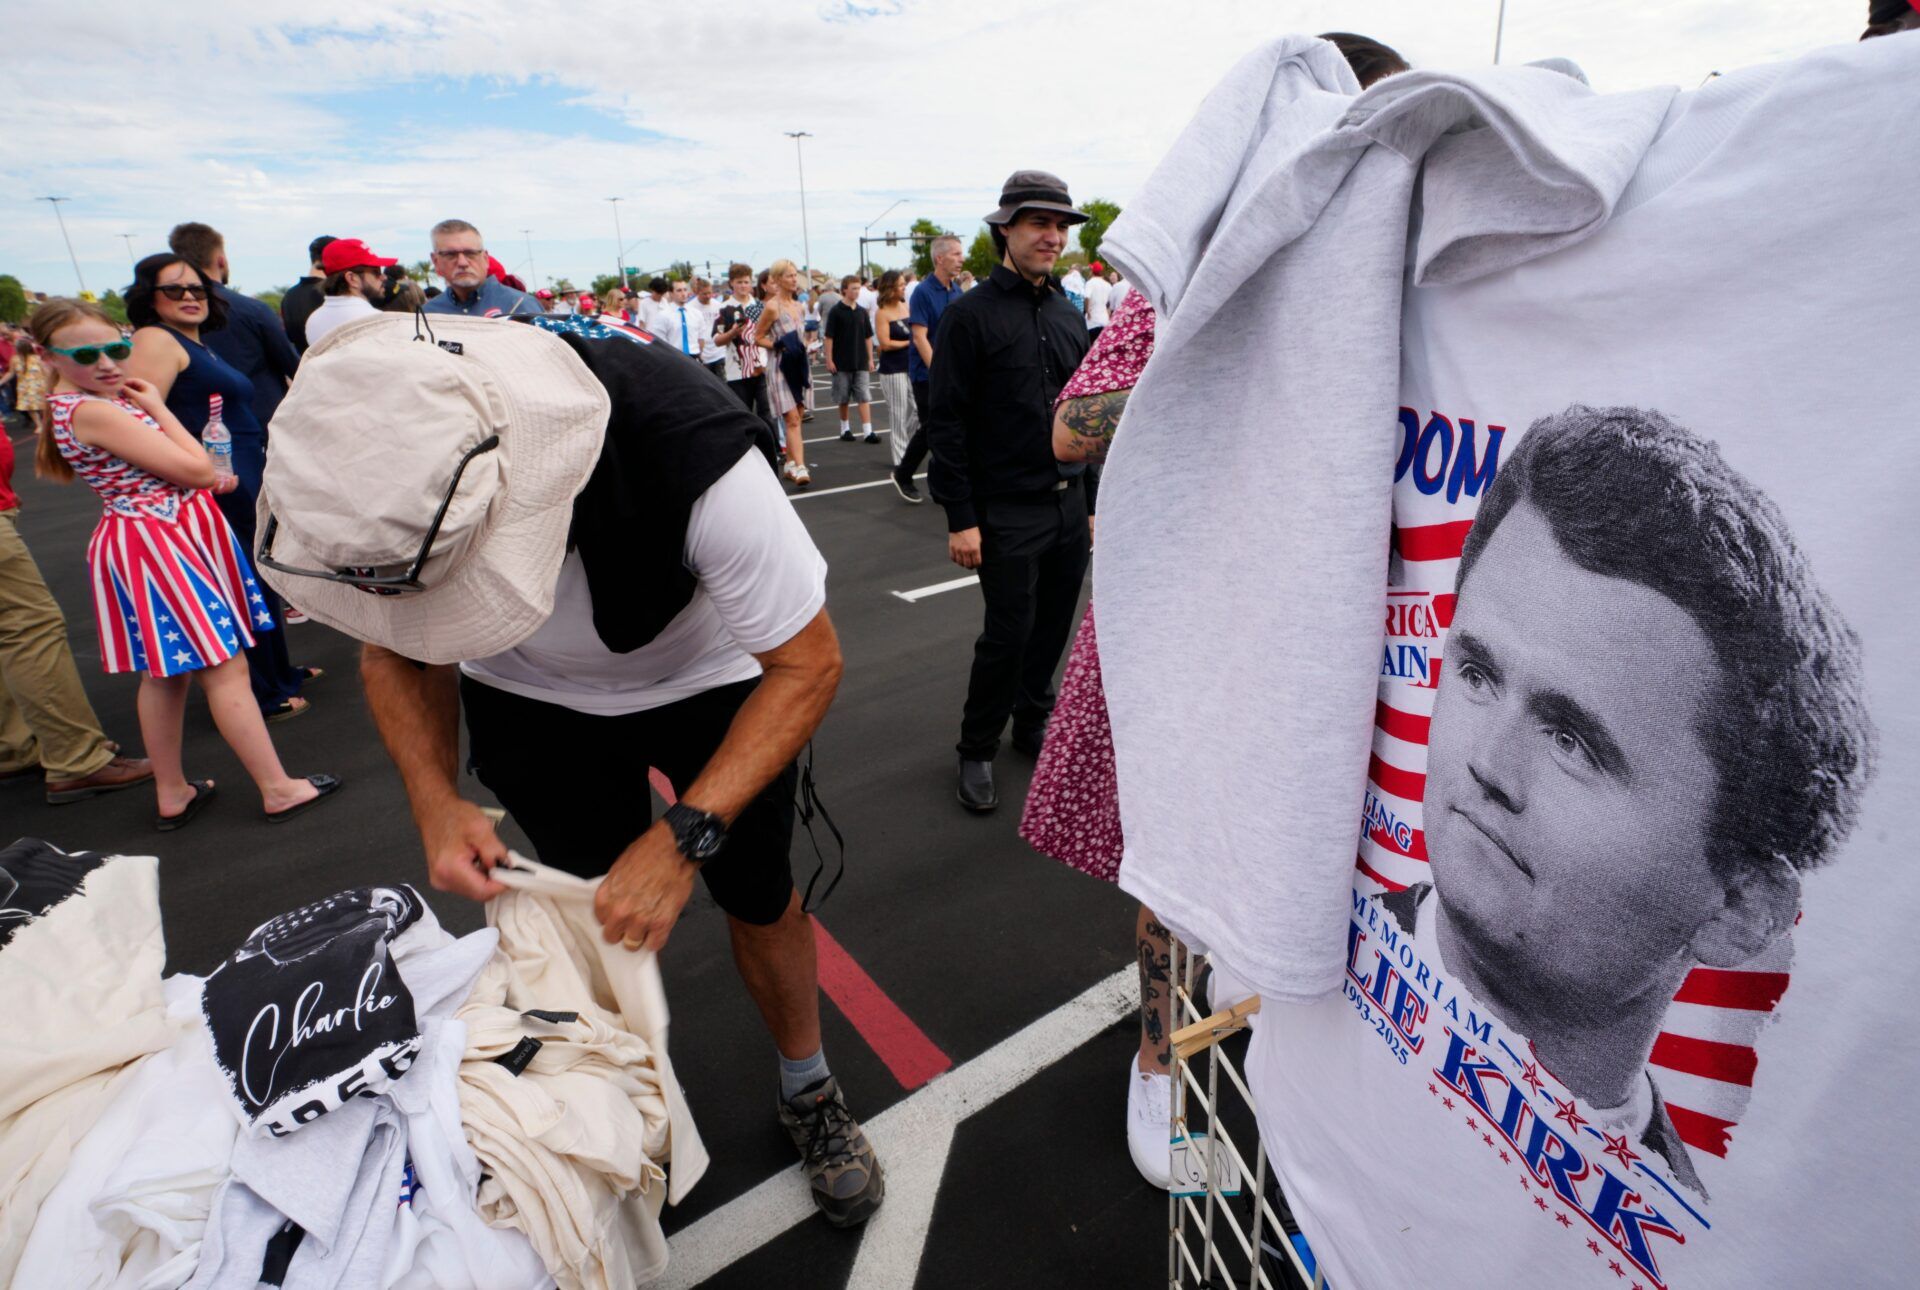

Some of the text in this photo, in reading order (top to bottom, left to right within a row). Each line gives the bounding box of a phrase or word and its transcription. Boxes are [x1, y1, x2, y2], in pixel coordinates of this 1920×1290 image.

[242, 962, 398, 1106] Charlie
[1342, 978, 1409, 1065] 1993-2025
[1352, 888, 1493, 1045] MEMORIAM
[1432, 1025, 1686, 1290] KIRK
